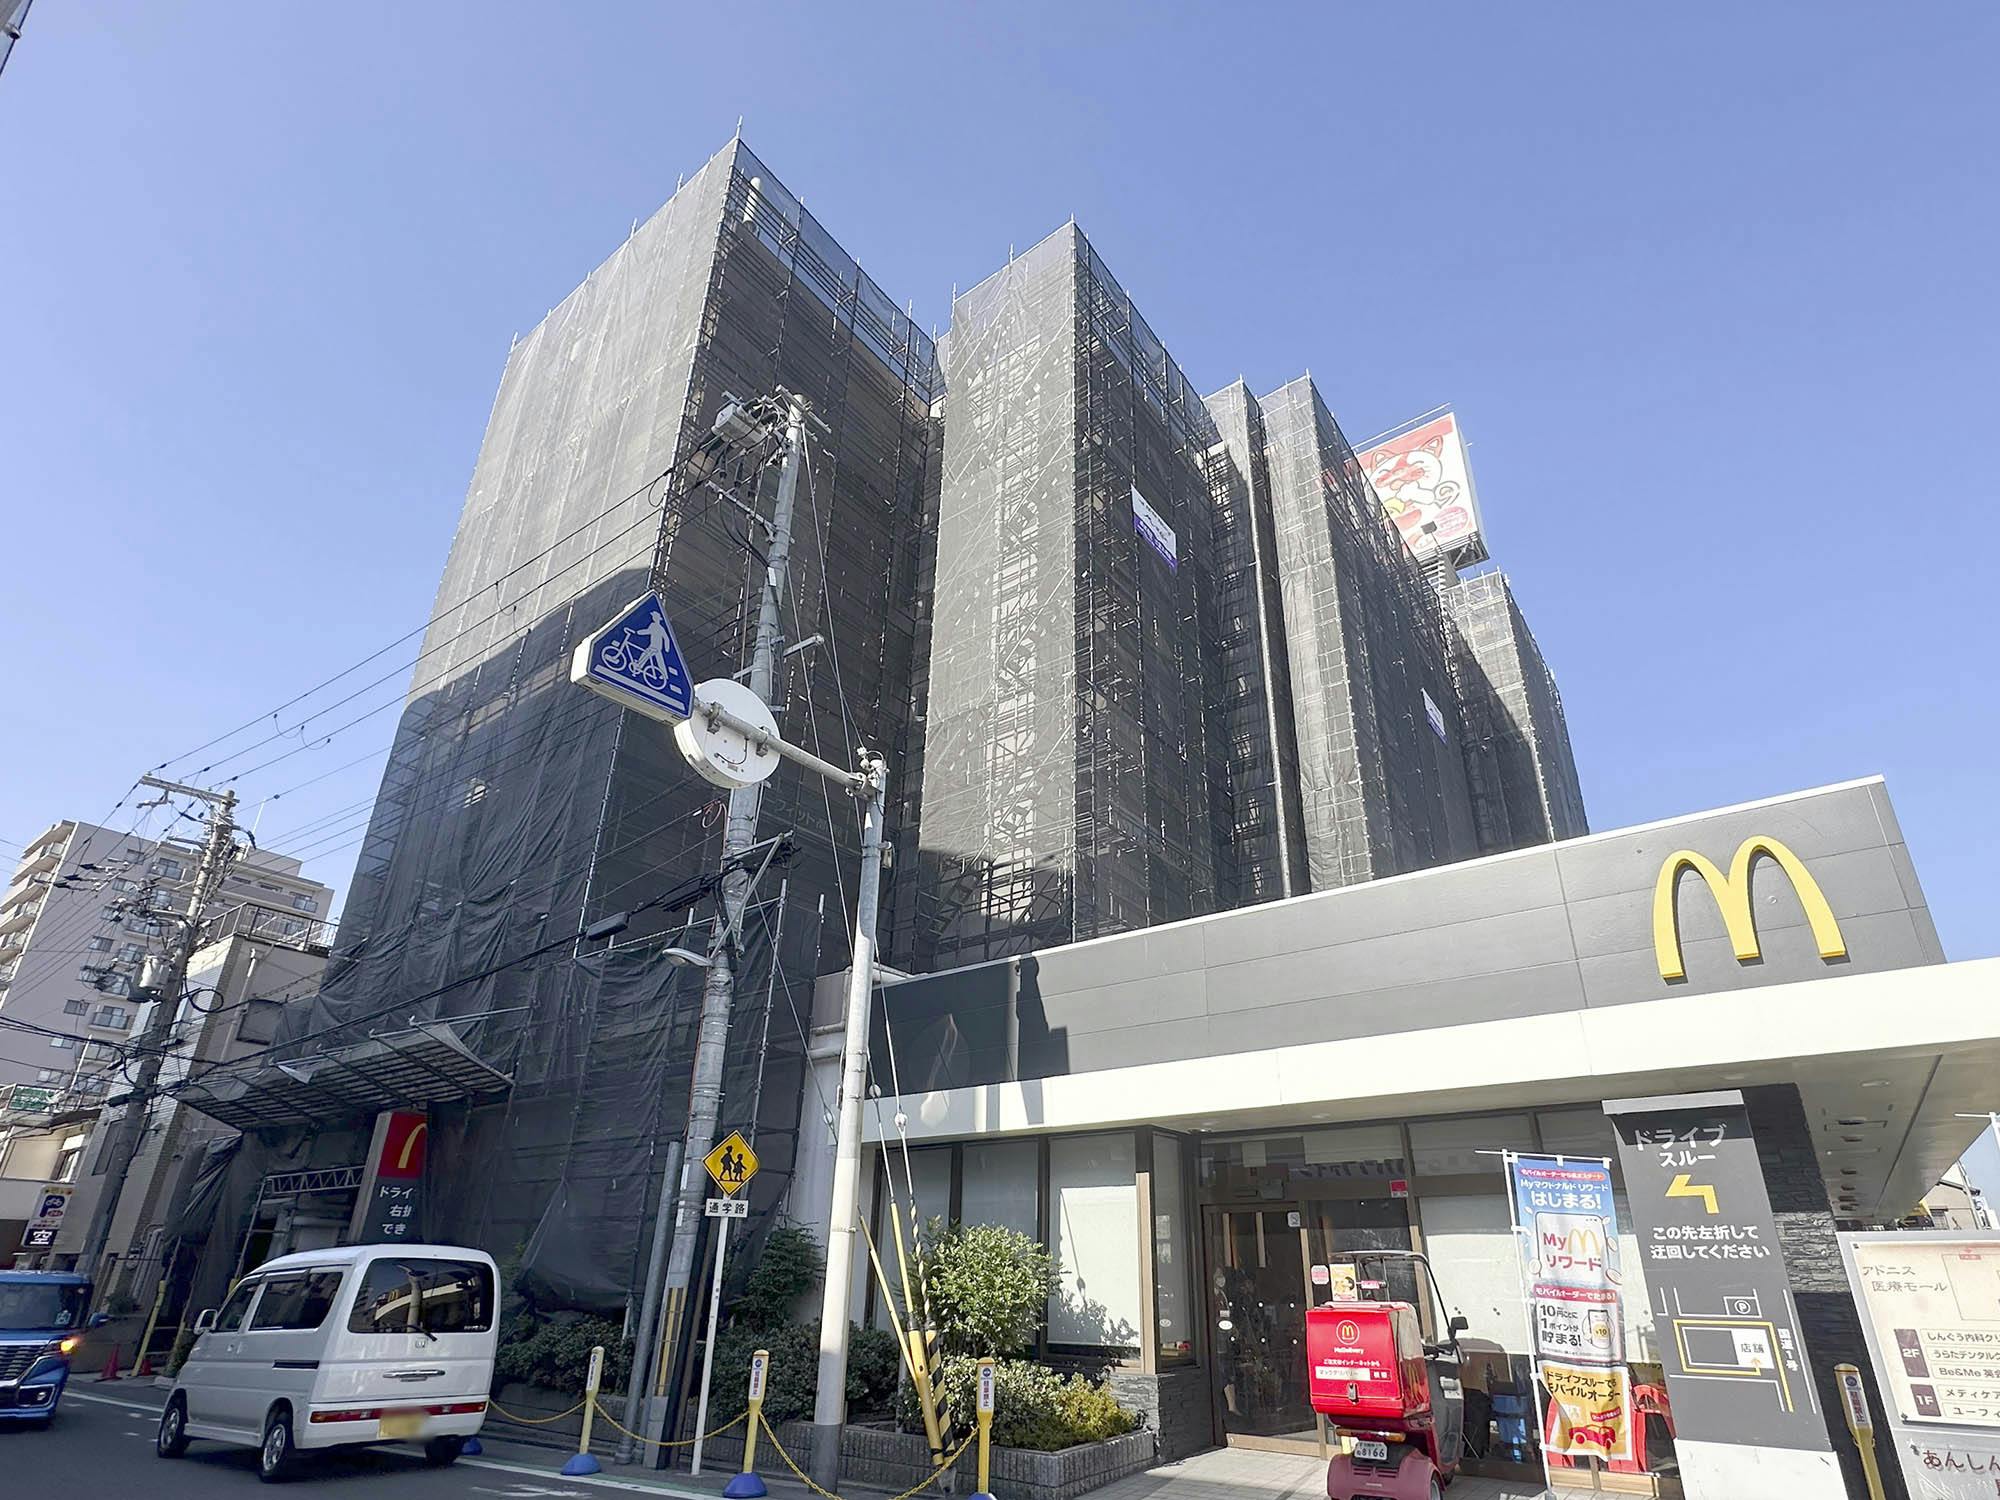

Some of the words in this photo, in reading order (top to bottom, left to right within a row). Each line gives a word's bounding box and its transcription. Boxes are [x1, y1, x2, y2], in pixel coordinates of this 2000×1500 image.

[1635, 1123, 1727, 1151] ドライブ
[1659, 1150, 1716, 1167] スルー
[710, 1202, 744, 1214] 通学路
[30, 1230, 53, 1244] 空
[1652, 1224, 1759, 1240] この先左折して
[1543, 1232, 1567, 1250] My
[1649, 1244, 1770, 1259] 迂回してください
[1546, 1254, 1601, 1271] リワード
[1863, 1265, 1916, 1276] アドニス
[1872, 1281, 1947, 1292] 医療モール
[1902, 1348, 1920, 1358] 2F
[1939, 1367, 1981, 1377] Be&Me
[1548, 1382, 1621, 1402] モバイルオーダー
[1916, 1395, 1934, 1405] 1F
